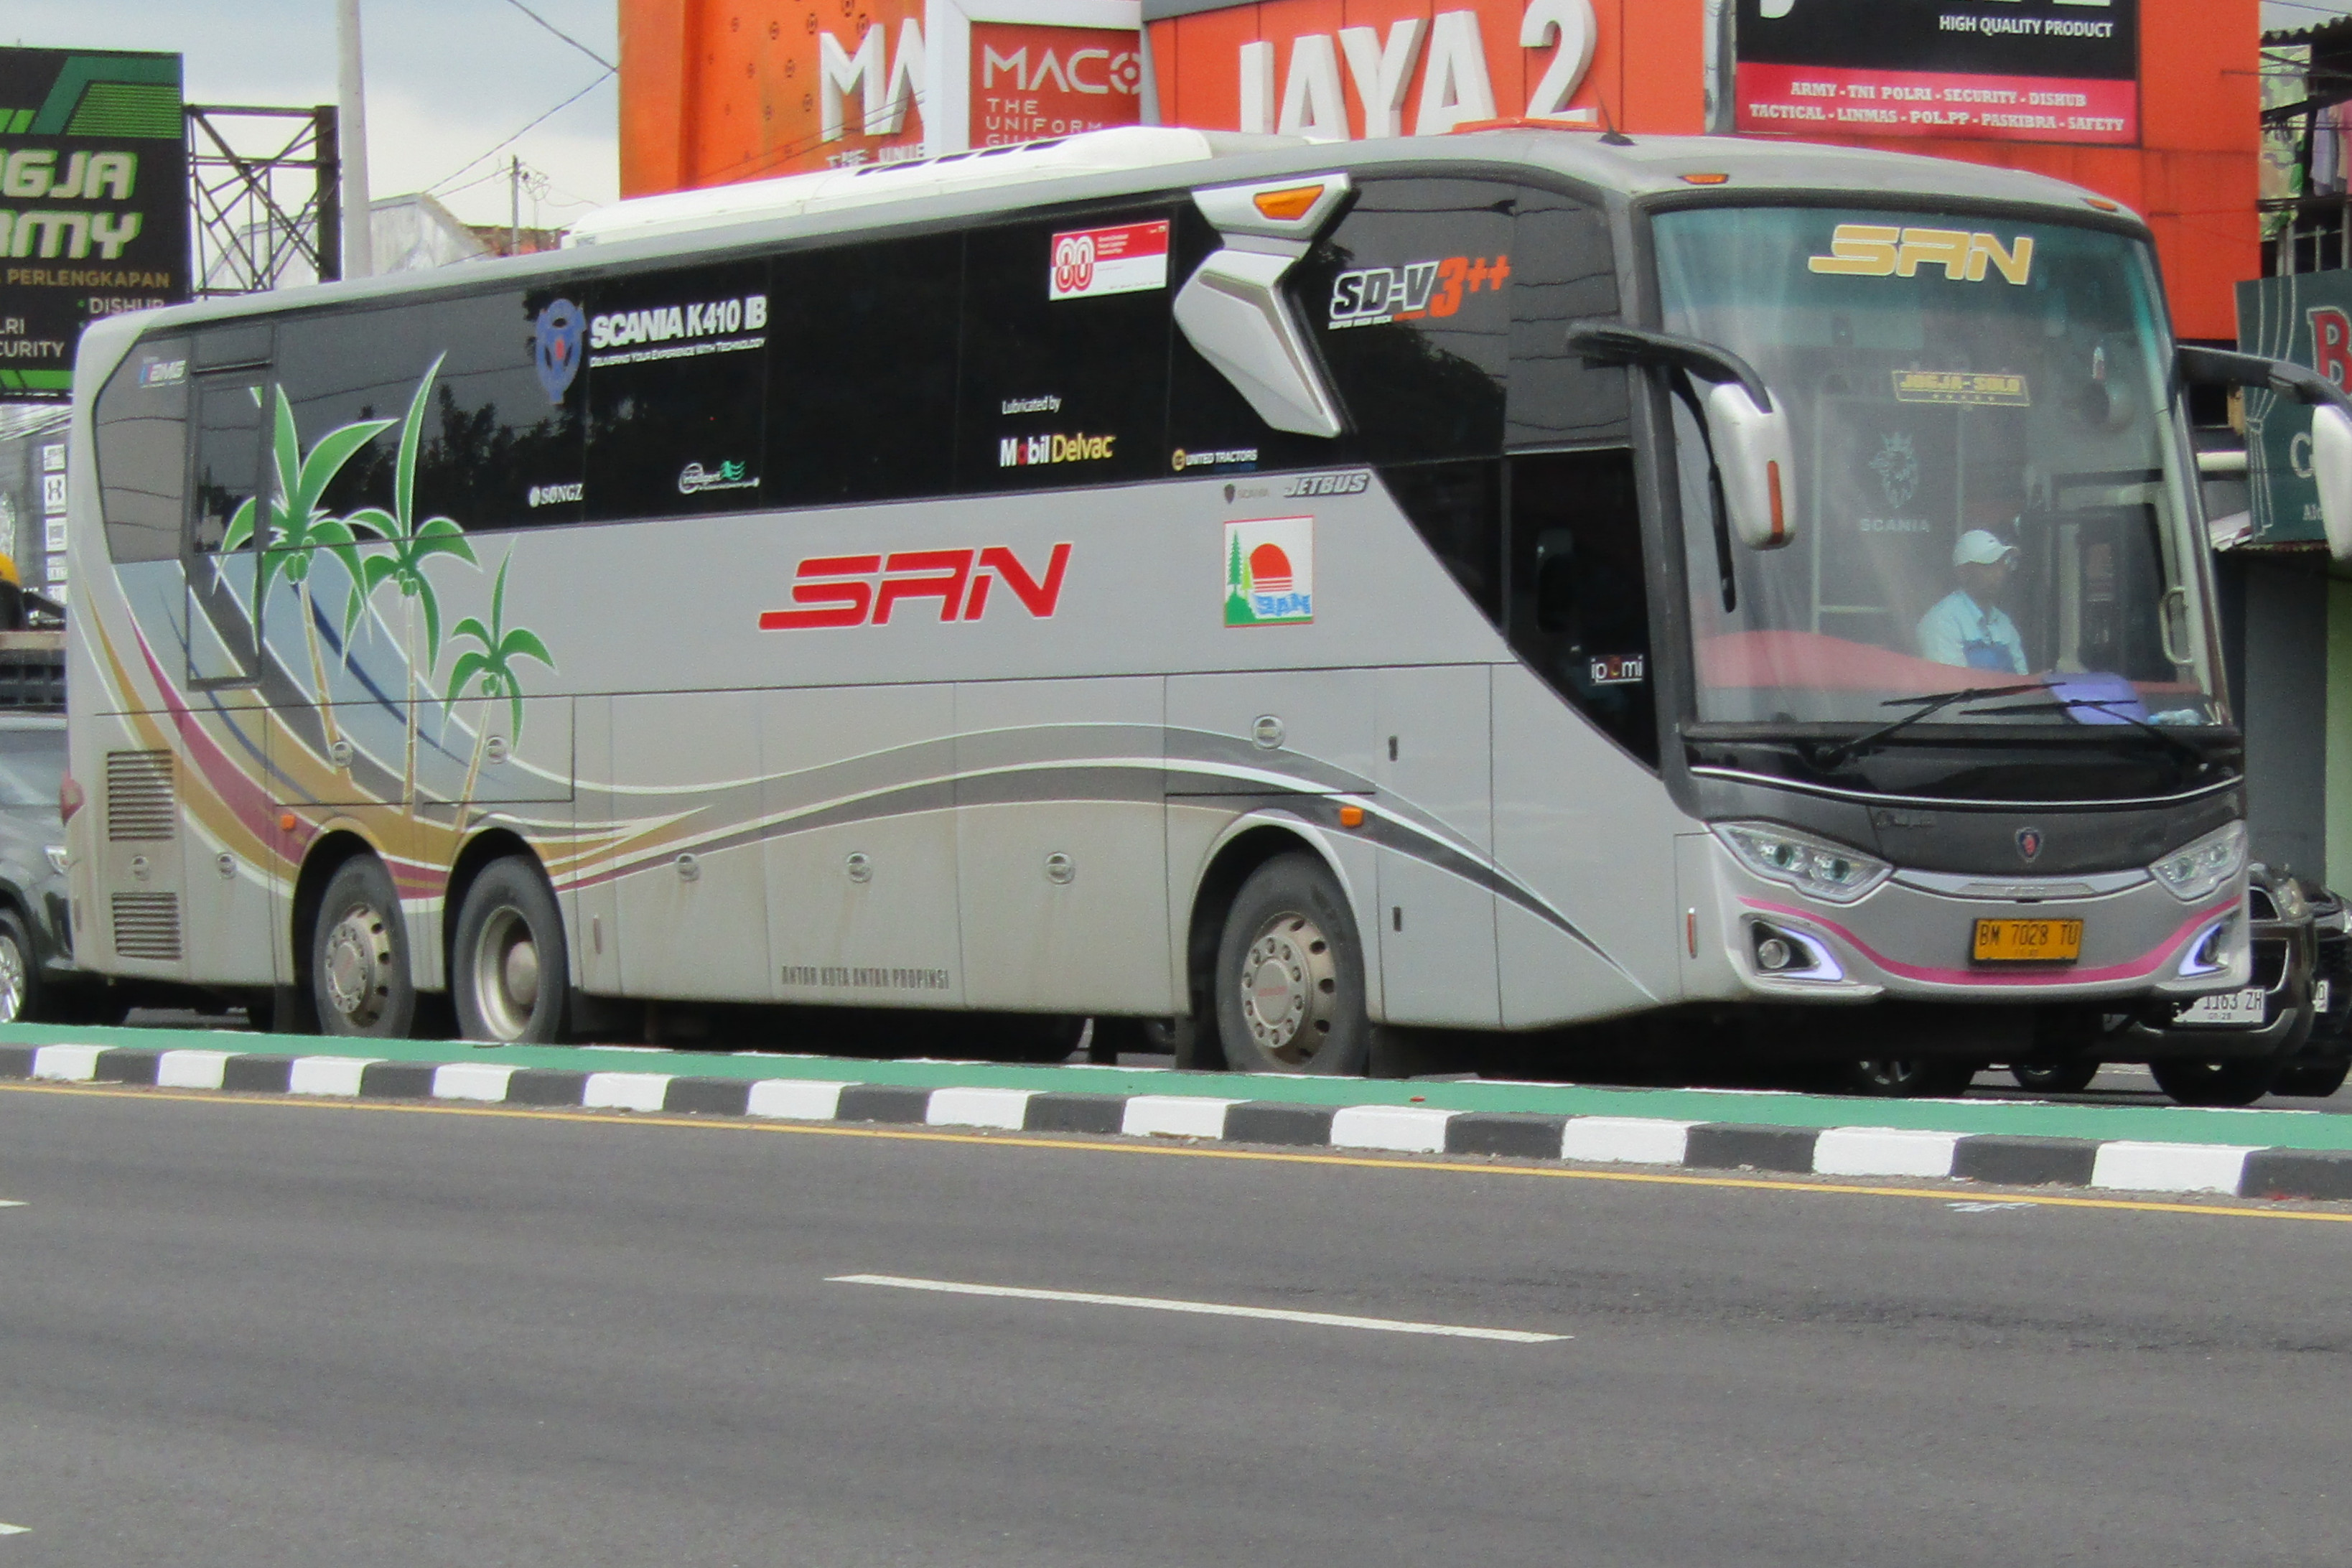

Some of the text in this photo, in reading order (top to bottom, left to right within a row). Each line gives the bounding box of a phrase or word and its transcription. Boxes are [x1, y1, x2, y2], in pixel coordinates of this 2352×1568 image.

[1939, 14, 2114, 37] HIGH QUALITY PRODUCT
[1519, 0, 1598, 123] 2
[986, 98, 1038, 115] THE
[1791, 81, 2086, 107] ARMY TNI POLRI SECURITY DISHUB
[1749, 103, 1826, 121] TACTICAL
[1837, 108, 1898, 123] LINMAS
[1982, 113, 2057, 129] PASKIBRA
[2068, 116, 2124, 131] SAFETY
[0, 148, 139, 200] GJA
[1808, 224, 2033, 285] SAN
[6, 268, 171, 289] PERLENGKAPAN
[590, 294, 767, 350] SCANIA K410 B
[0, 340, 65, 358] URITY
[1002, 395, 1062, 415] Lubricated by
[1000, 431, 1113, 467] Mobil Delvac
[540, 483, 584, 505] SONGZ
[759, 543, 1073, 630] SAN
[2011, 923, 2048, 946] 7028
